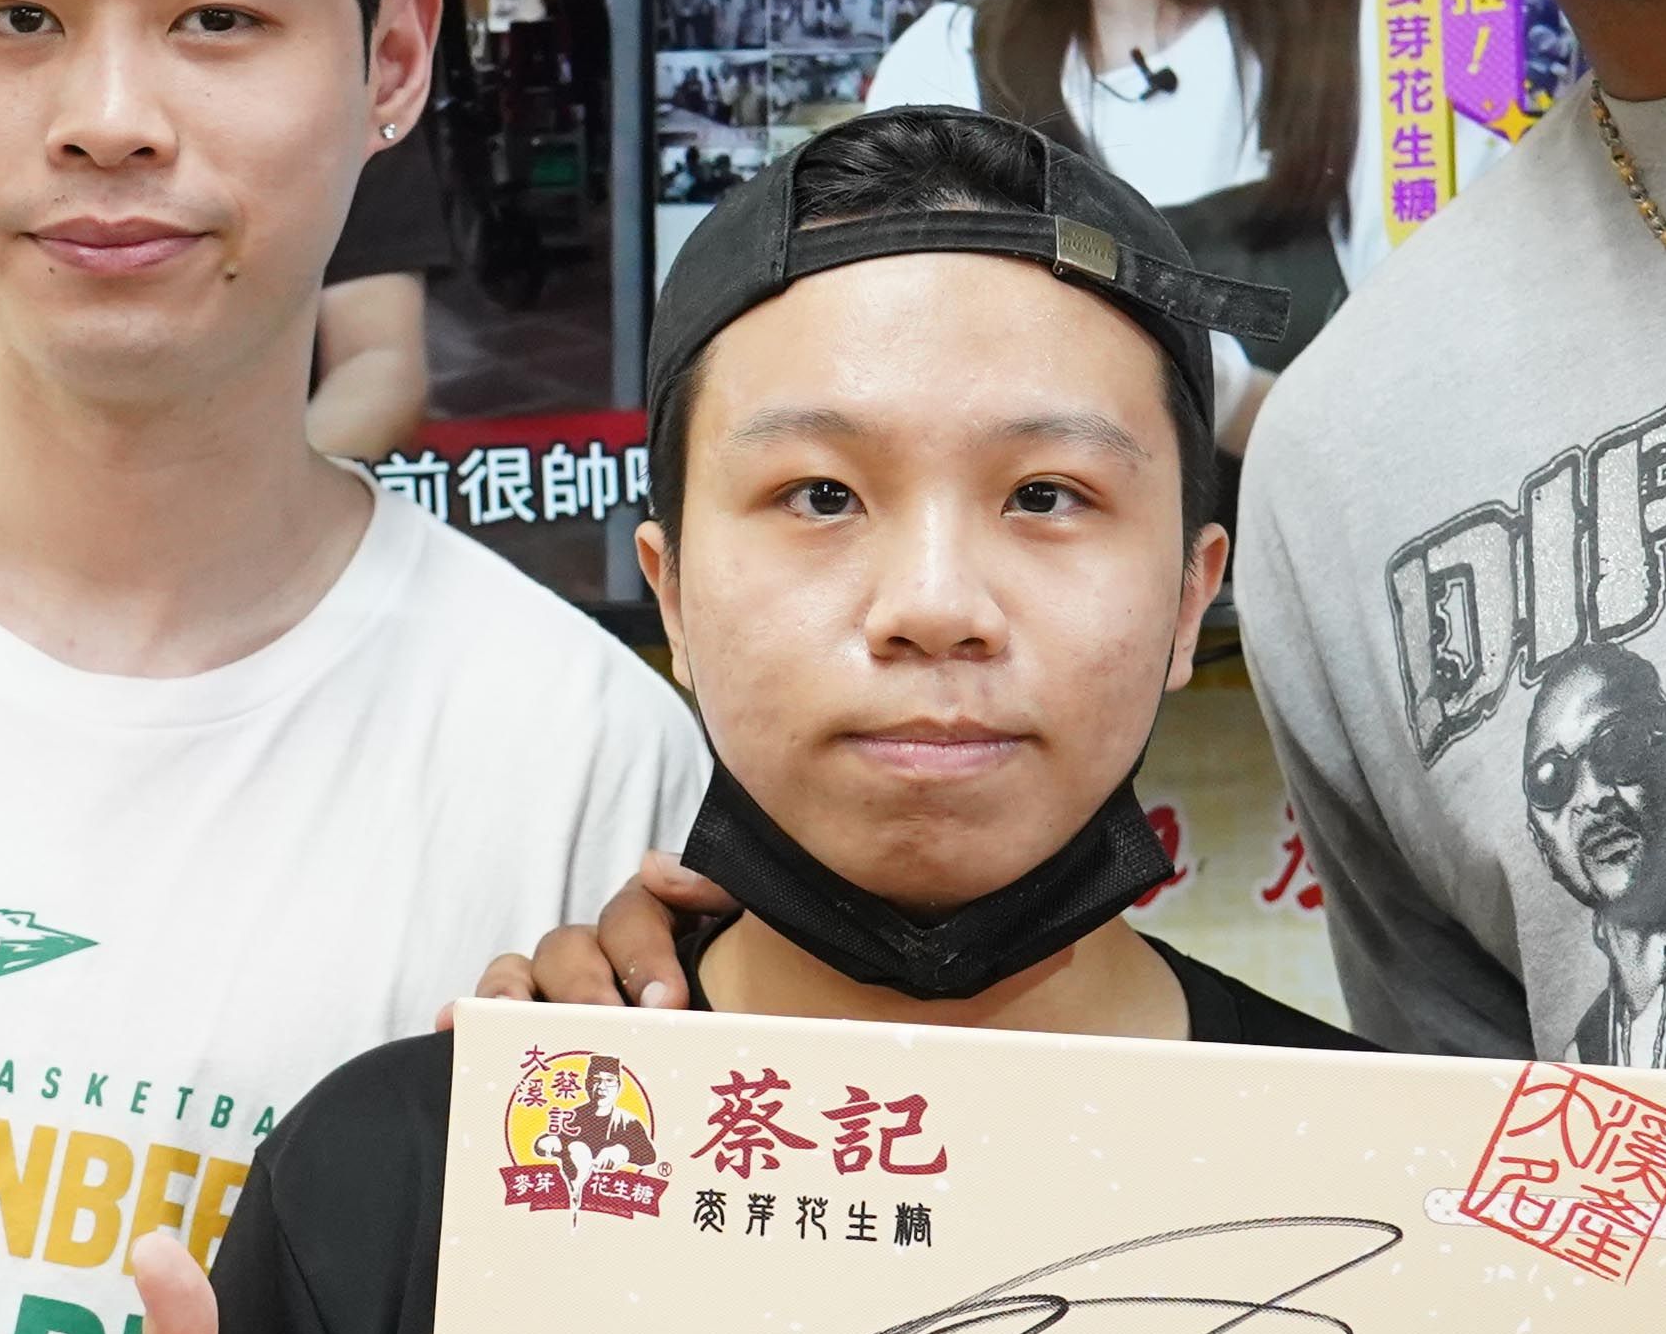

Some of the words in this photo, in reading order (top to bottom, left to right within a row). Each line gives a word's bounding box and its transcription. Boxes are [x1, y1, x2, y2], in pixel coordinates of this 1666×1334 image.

[519, 1043, 551, 1108] 大溪
[546, 1069, 583, 1136] 蔡記
[689, 1067, 948, 1180] 蔡記
[589, 1173, 655, 1206] 花生糖
[692, 1188, 934, 1249] 麥芽花生糖
